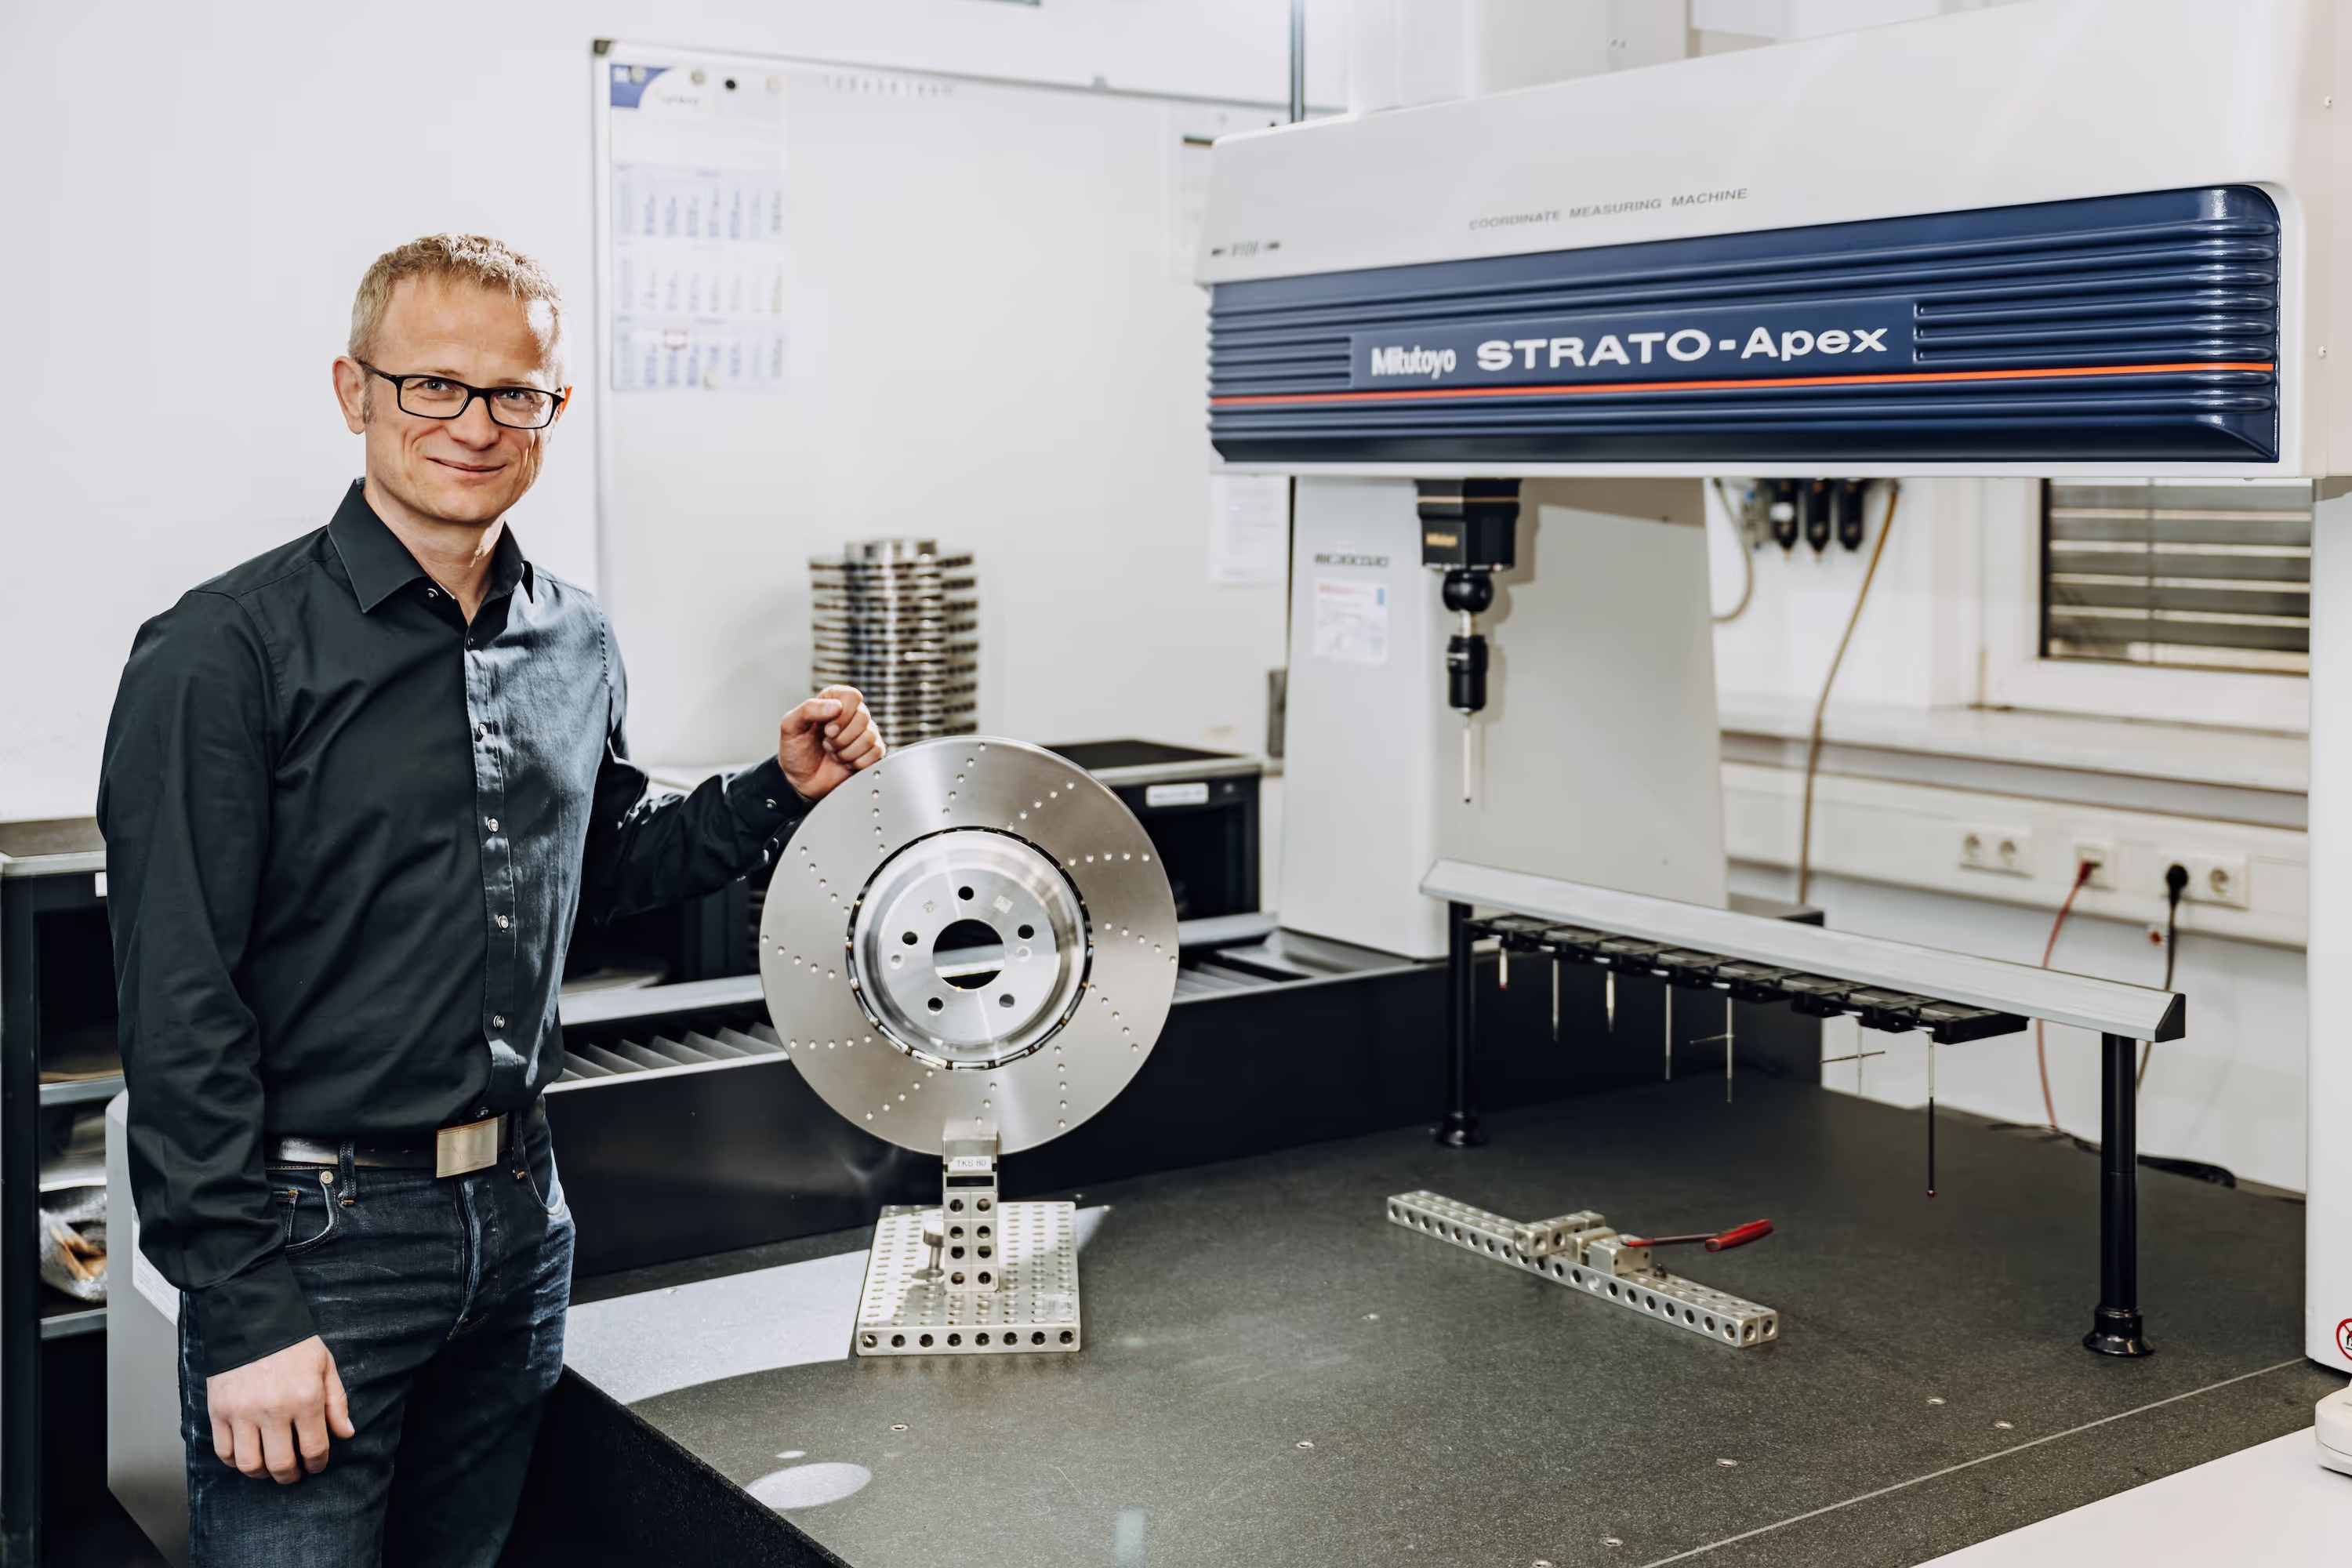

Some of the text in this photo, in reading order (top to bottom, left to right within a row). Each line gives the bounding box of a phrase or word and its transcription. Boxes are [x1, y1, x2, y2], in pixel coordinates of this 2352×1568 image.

[1468, 187, 1748, 230] COORDINATE MEASURING MACHINE
[1370, 346, 1457, 379] Mitutoyo
